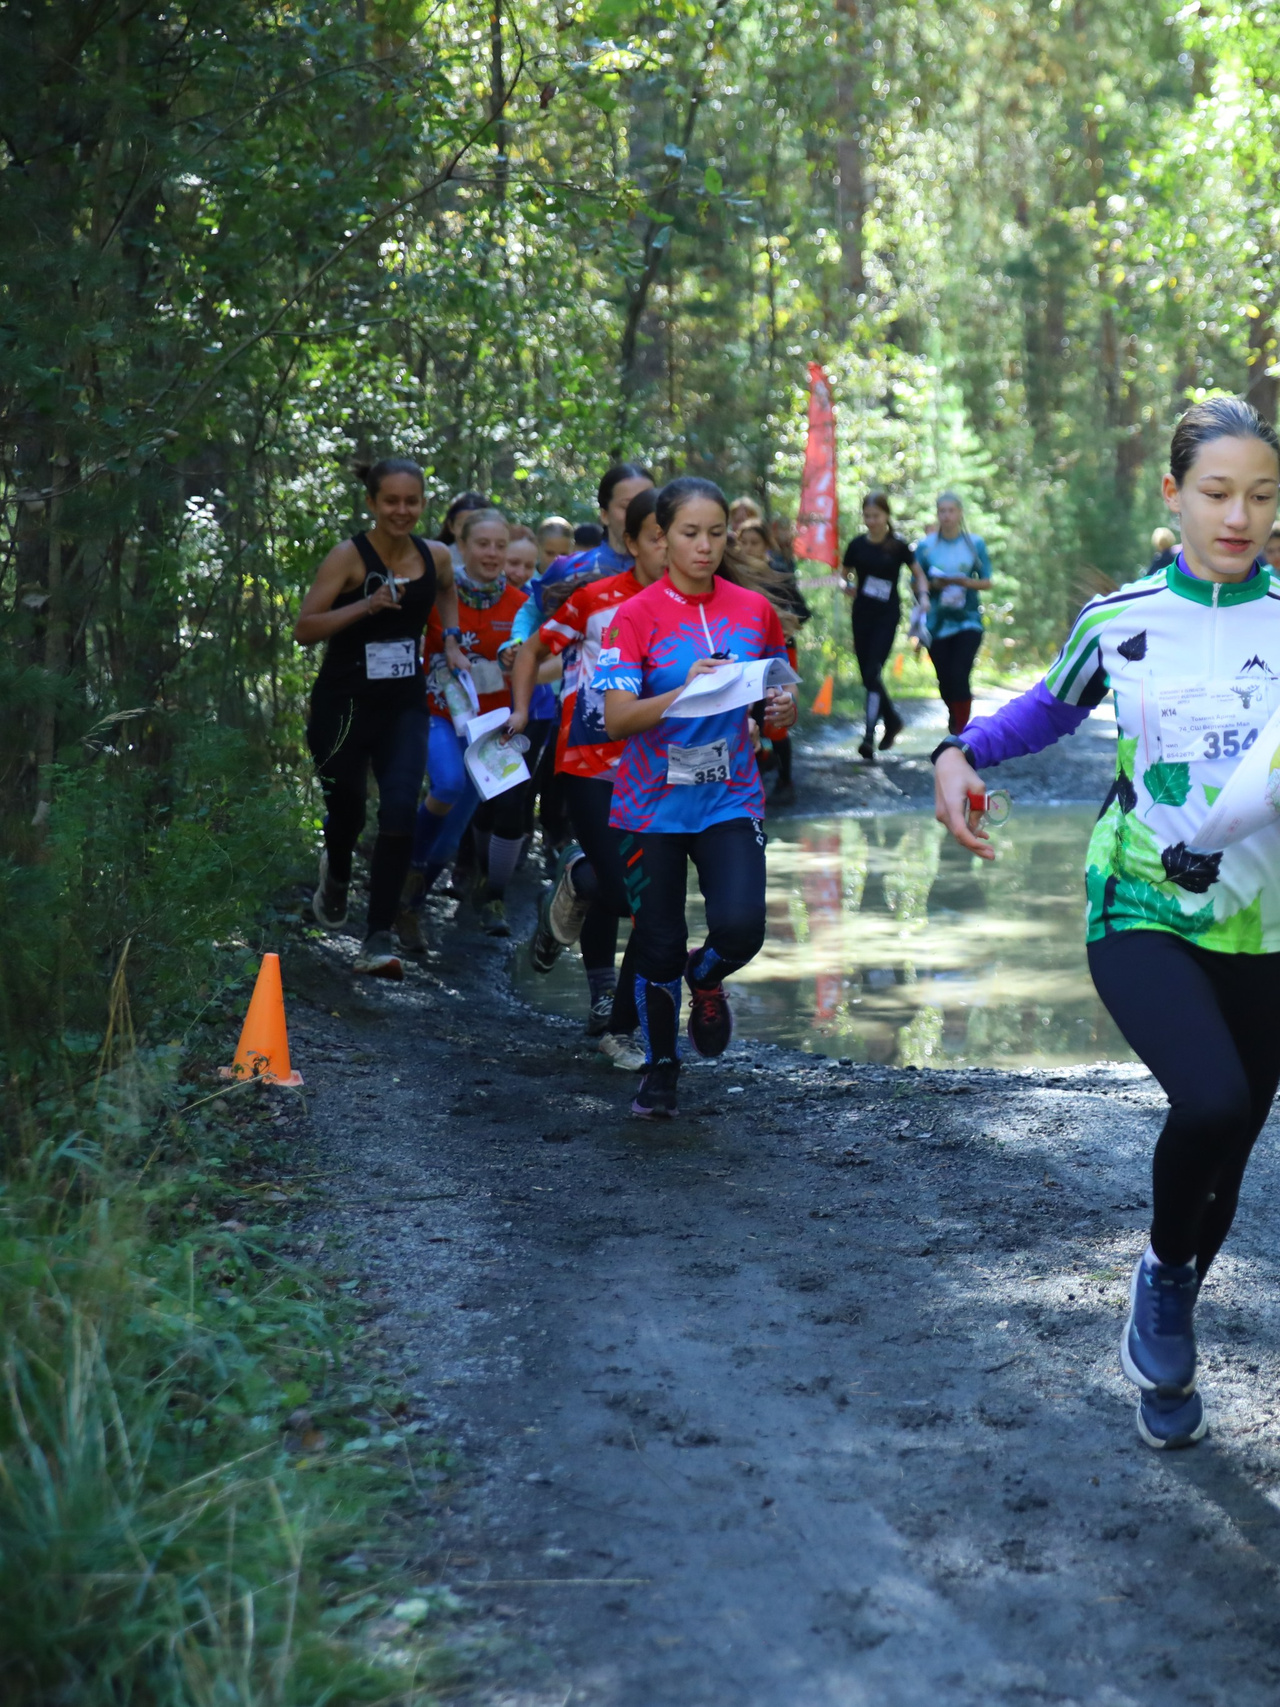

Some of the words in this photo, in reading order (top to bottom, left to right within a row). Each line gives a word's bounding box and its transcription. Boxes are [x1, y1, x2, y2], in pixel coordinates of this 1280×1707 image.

[391, 663, 413, 677] 371
[1161, 708, 1177, 718] Ж14
[1203, 728, 1259, 760] 354
[694, 764, 727, 785] 353
